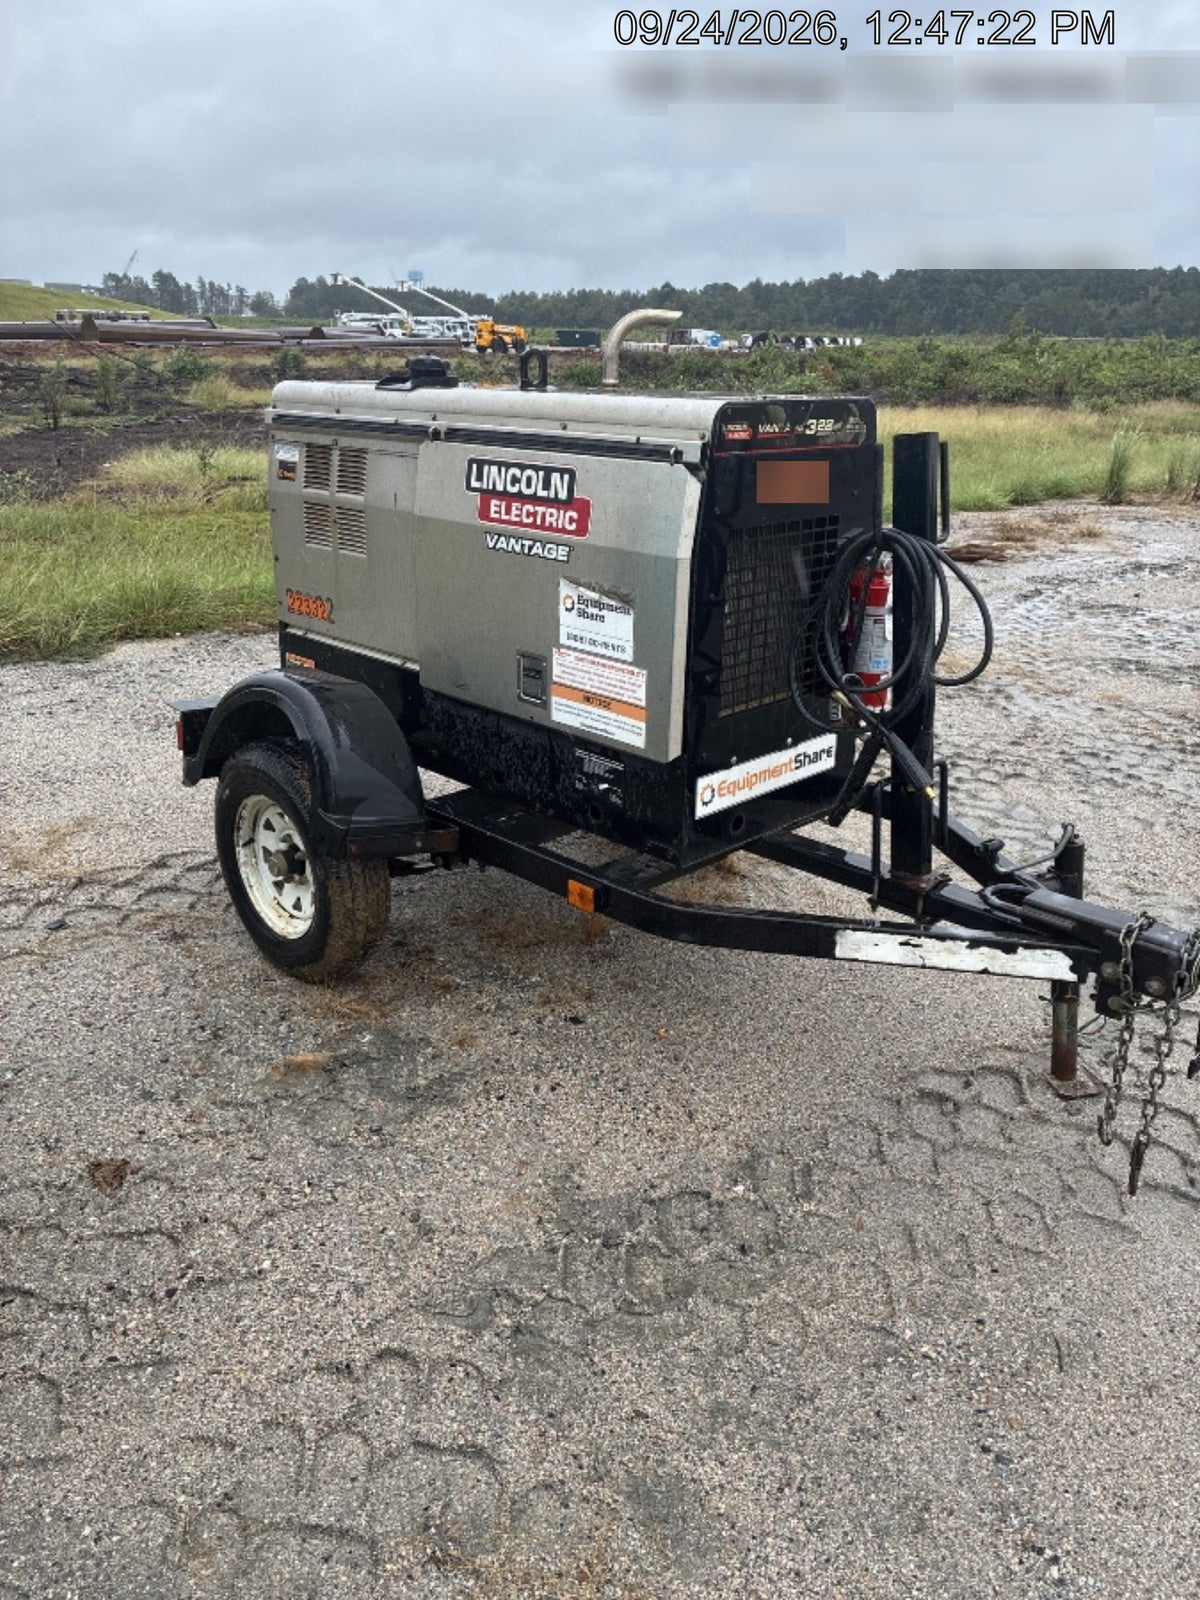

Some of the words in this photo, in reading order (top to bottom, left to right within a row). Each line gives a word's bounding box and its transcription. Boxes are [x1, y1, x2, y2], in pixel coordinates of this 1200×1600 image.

[470, 463, 569, 500] LINCOLN
[489, 499, 578, 531] ELECTRIC
[485, 533, 570, 562] VANTAGE
[577, 594, 632, 616] Equipment
[577, 607, 606, 623] Share
[717, 746, 834, 798] EquipmentShare
